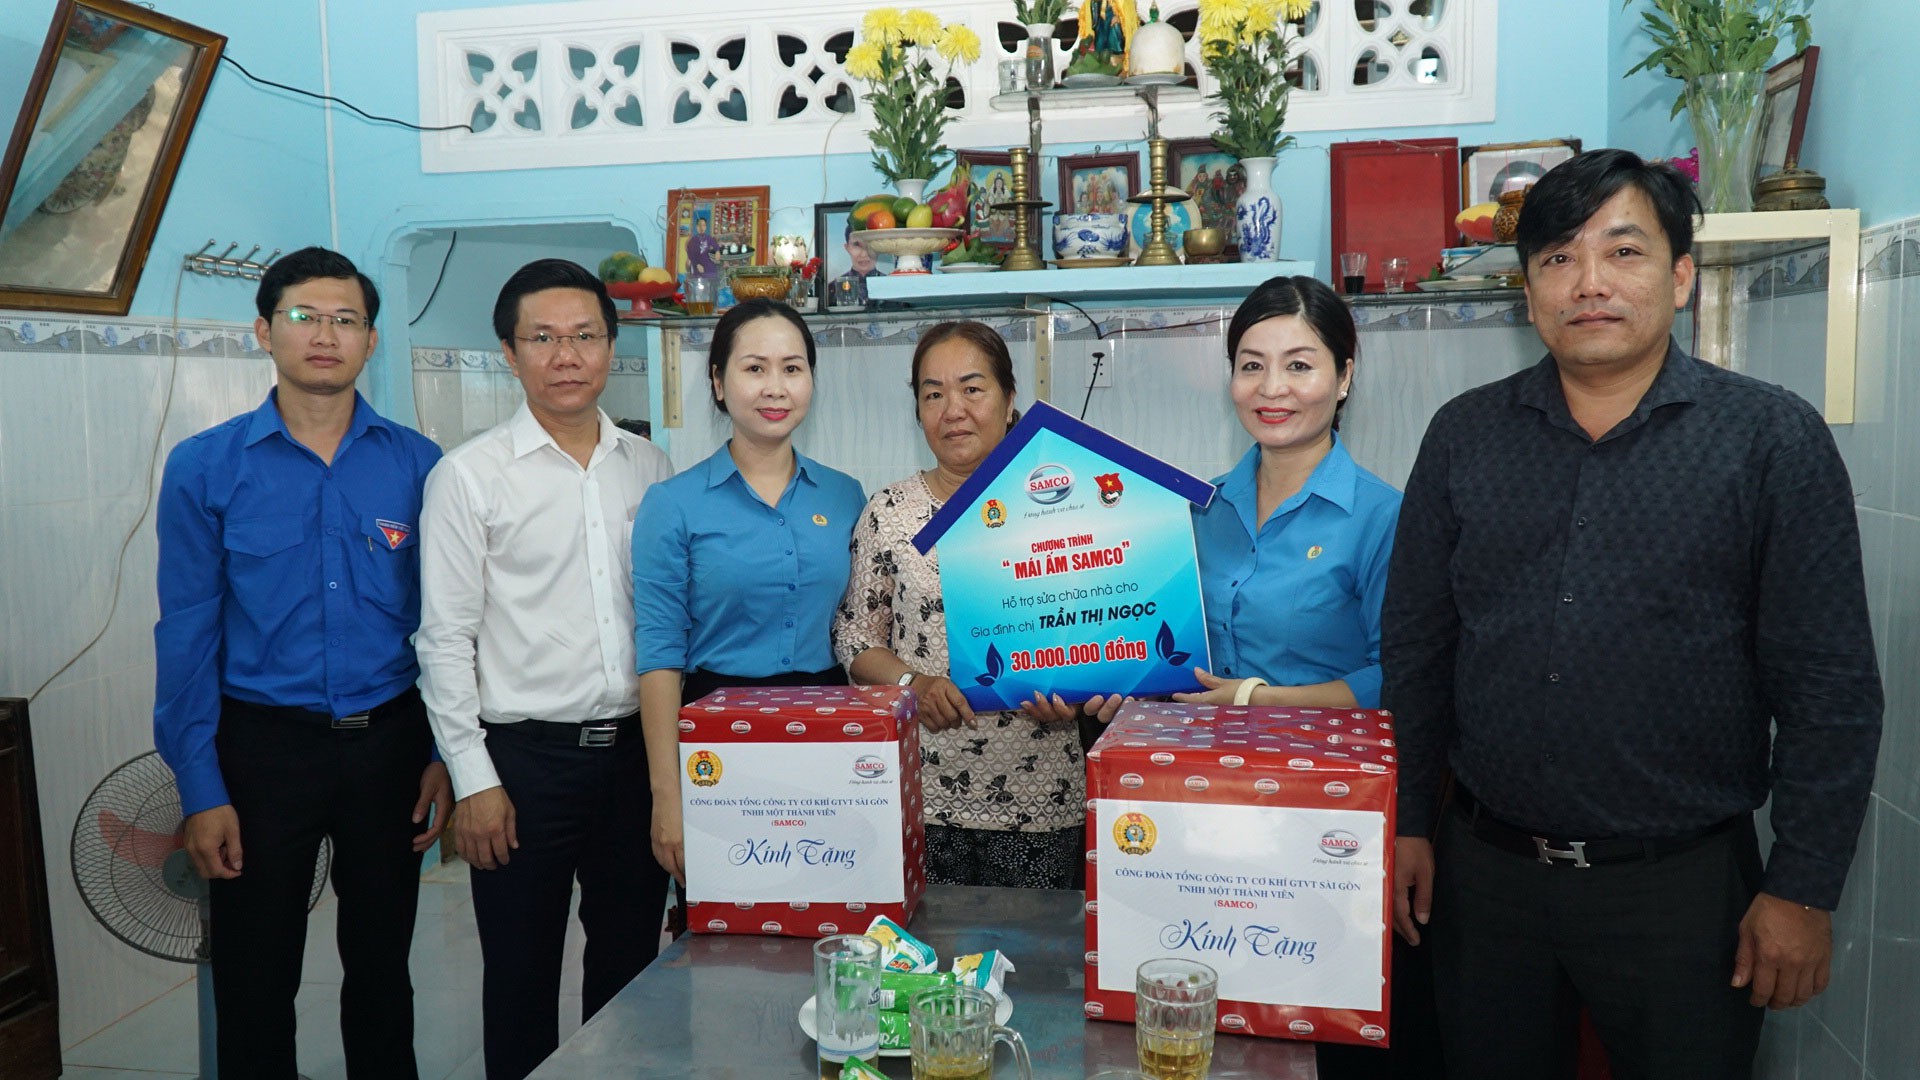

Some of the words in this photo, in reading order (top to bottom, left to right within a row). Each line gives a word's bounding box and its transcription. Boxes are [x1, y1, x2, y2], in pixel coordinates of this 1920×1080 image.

[1030, 476, 1069, 491] SAMCO
[1031, 538, 1066, 553] CHƯƠNG
[1067, 534, 1094, 548] TRÌNH
[1014, 557, 1042, 579] MÁI
[1046, 552, 1069, 575] ẤM
[1002, 595, 1017, 609] Hỗ
[1020, 596, 1034, 608] trợ
[1036, 592, 1056, 605] sửa
[1058, 588, 1088, 602] chữa
[1090, 584, 1113, 597] nhà
[1115, 582, 1139, 594] cho
[970, 626, 990, 638] Gia
[1018, 620, 1035, 633] chị
[1039, 607, 1077, 629] TRẦN
[1081, 608, 1103, 626] THỊ
[1108, 601, 1157, 621] NGỌC
[1011, 642, 1101, 672] 30.000.000
[1105, 636, 1148, 662] đồng
[854, 762, 885, 770] SAMCO
[689, 798, 713, 807] CÔNG
[714, 798, 737, 807] ĐOÀN
[738, 797, 762, 807] TỔNG
[762, 798, 787, 806] CÔNG
[800, 798, 813, 806] CƠ
[814, 797, 830, 806] KHÍ
[831, 798, 853, 806] GTVT
[854, 797, 869, 806] SÀI
[870, 797, 889, 806] GÒN
[765, 808, 786, 818] MỘT
[786, 808, 816, 816] THÀNH
[816, 808, 836, 816] VIÊN
[771, 819, 807, 827] (SAMCO)
[1321, 838, 1359, 848] SAMCO
[727, 838, 792, 868] Kính
[796, 839, 856, 869] Tặng
[1115, 867, 1143, 878] CÔNG
[1145, 868, 1173, 880] ĐOÀN
[1175, 869, 1203, 881] TỔNG
[1204, 872, 1234, 883] CÔNG
[1235, 876, 1249, 885] TY
[1251, 877, 1266, 886] CƠ
[1268, 877, 1288, 887] KHÍ
[1289, 879, 1317, 889] GTVT
[1319, 880, 1336, 890] SÀI
[1338, 881, 1362, 891] GÒN
[1178, 884, 1206, 894] TNHH
[1208, 886, 1230, 897] MỘT
[1233, 888, 1268, 898] THÀNH
[1270, 889, 1295, 899] VIÊN
[1214, 899, 1258, 910] (SAMCO)
[1159, 918, 1237, 958] Kính
[1243, 925, 1317, 964] Tặng
